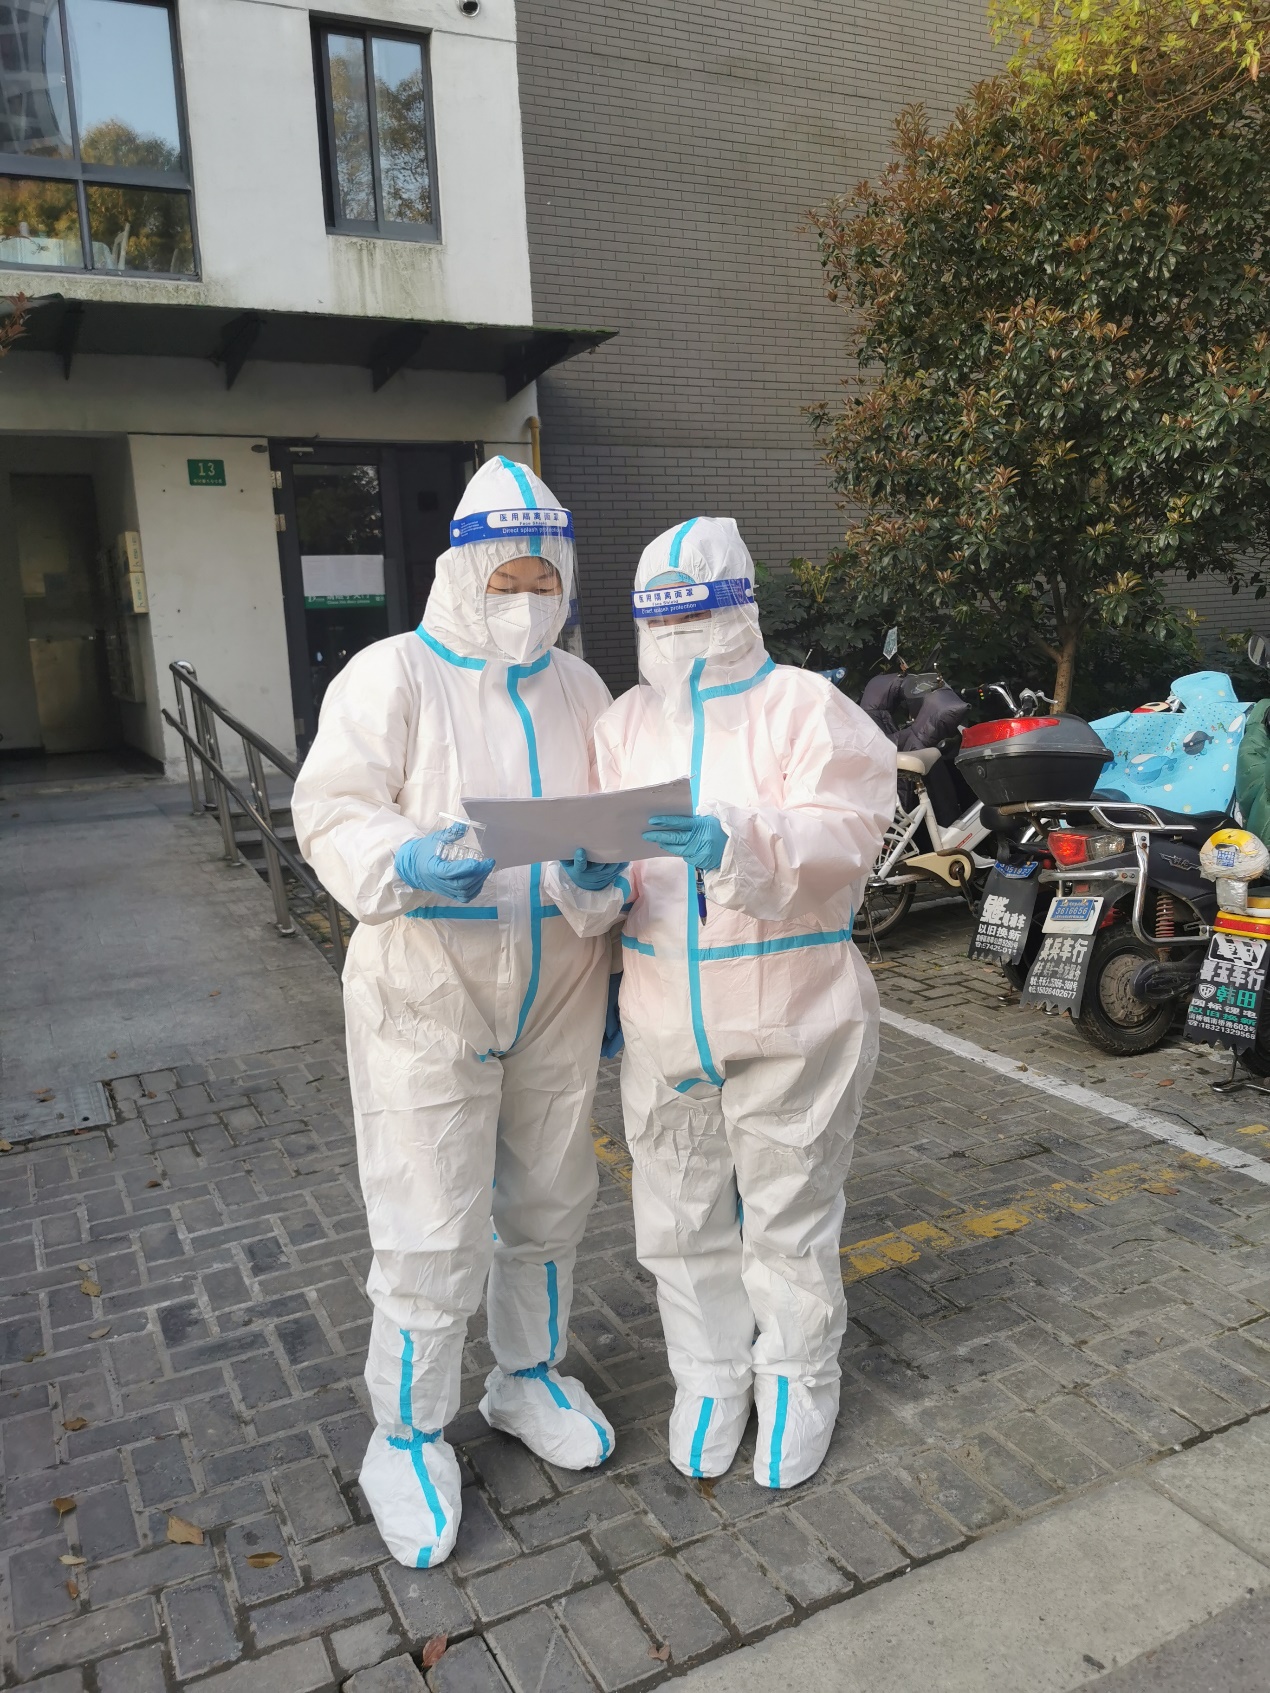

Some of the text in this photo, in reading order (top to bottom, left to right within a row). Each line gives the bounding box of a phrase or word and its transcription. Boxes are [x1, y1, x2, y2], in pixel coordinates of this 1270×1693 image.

[198, 462, 216, 476] 13
[499, 511, 560, 522] 医用隔离面罩
[638, 588, 694, 603] 医用隔离面罩
[670, 603, 697, 612] protection
[978, 924, 1022, 941] 以旧换新
[1216, 985, 1257, 1009] 韩田
[1189, 1005, 1257, 1026] 以旧换新
